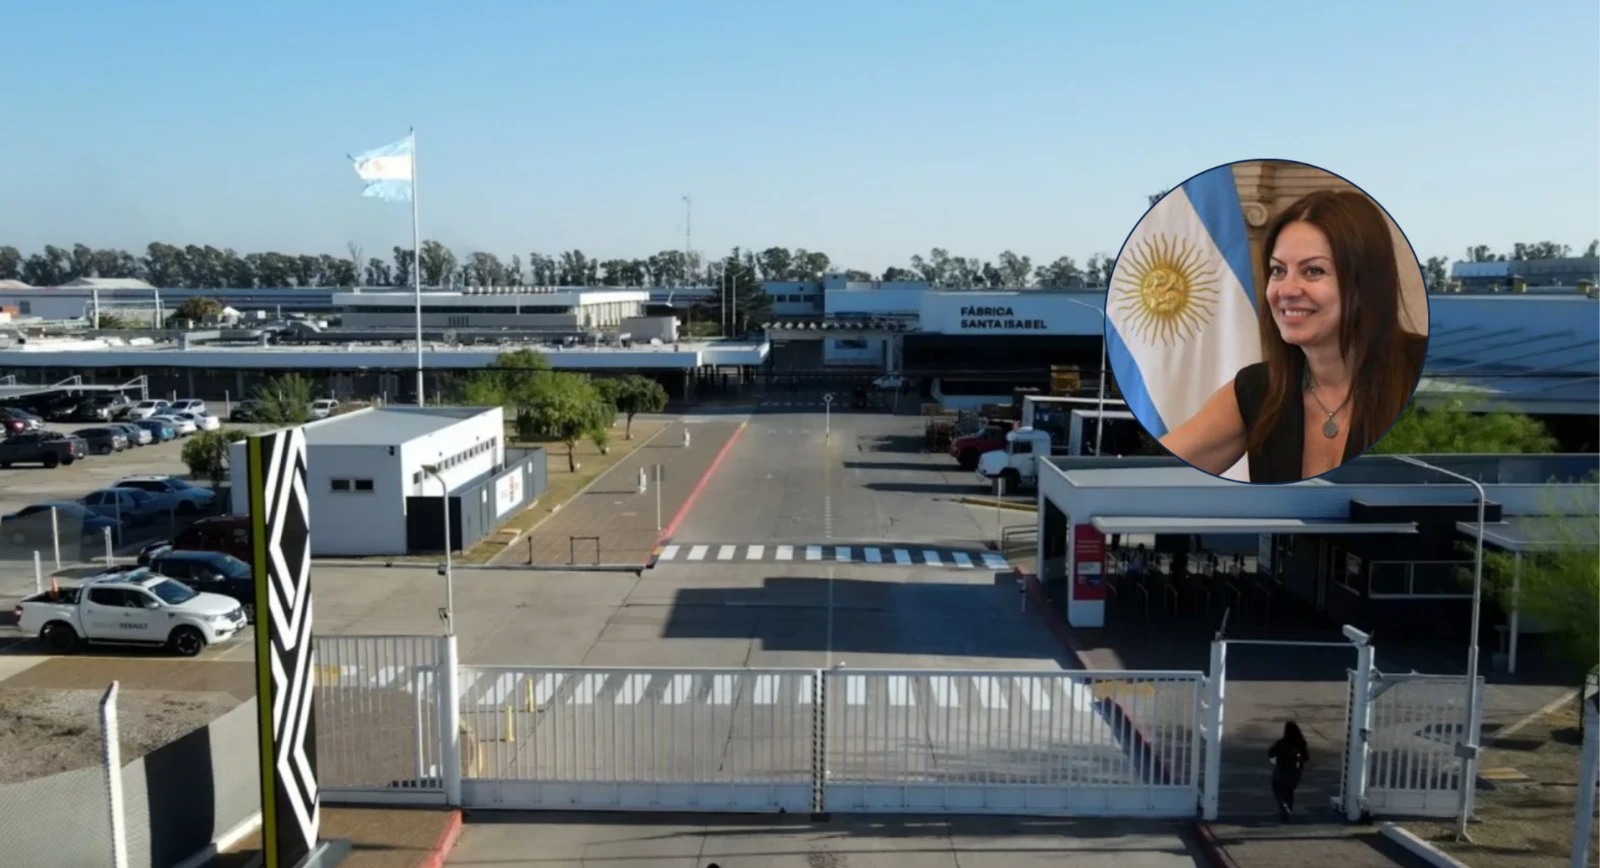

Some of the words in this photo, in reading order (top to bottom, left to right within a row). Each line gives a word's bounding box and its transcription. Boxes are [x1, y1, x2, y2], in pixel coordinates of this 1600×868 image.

[960, 305, 1014, 316] FÁBRICA
[960, 319, 1002, 329] SANTA
[1004, 319, 1048, 329] ISABEL
